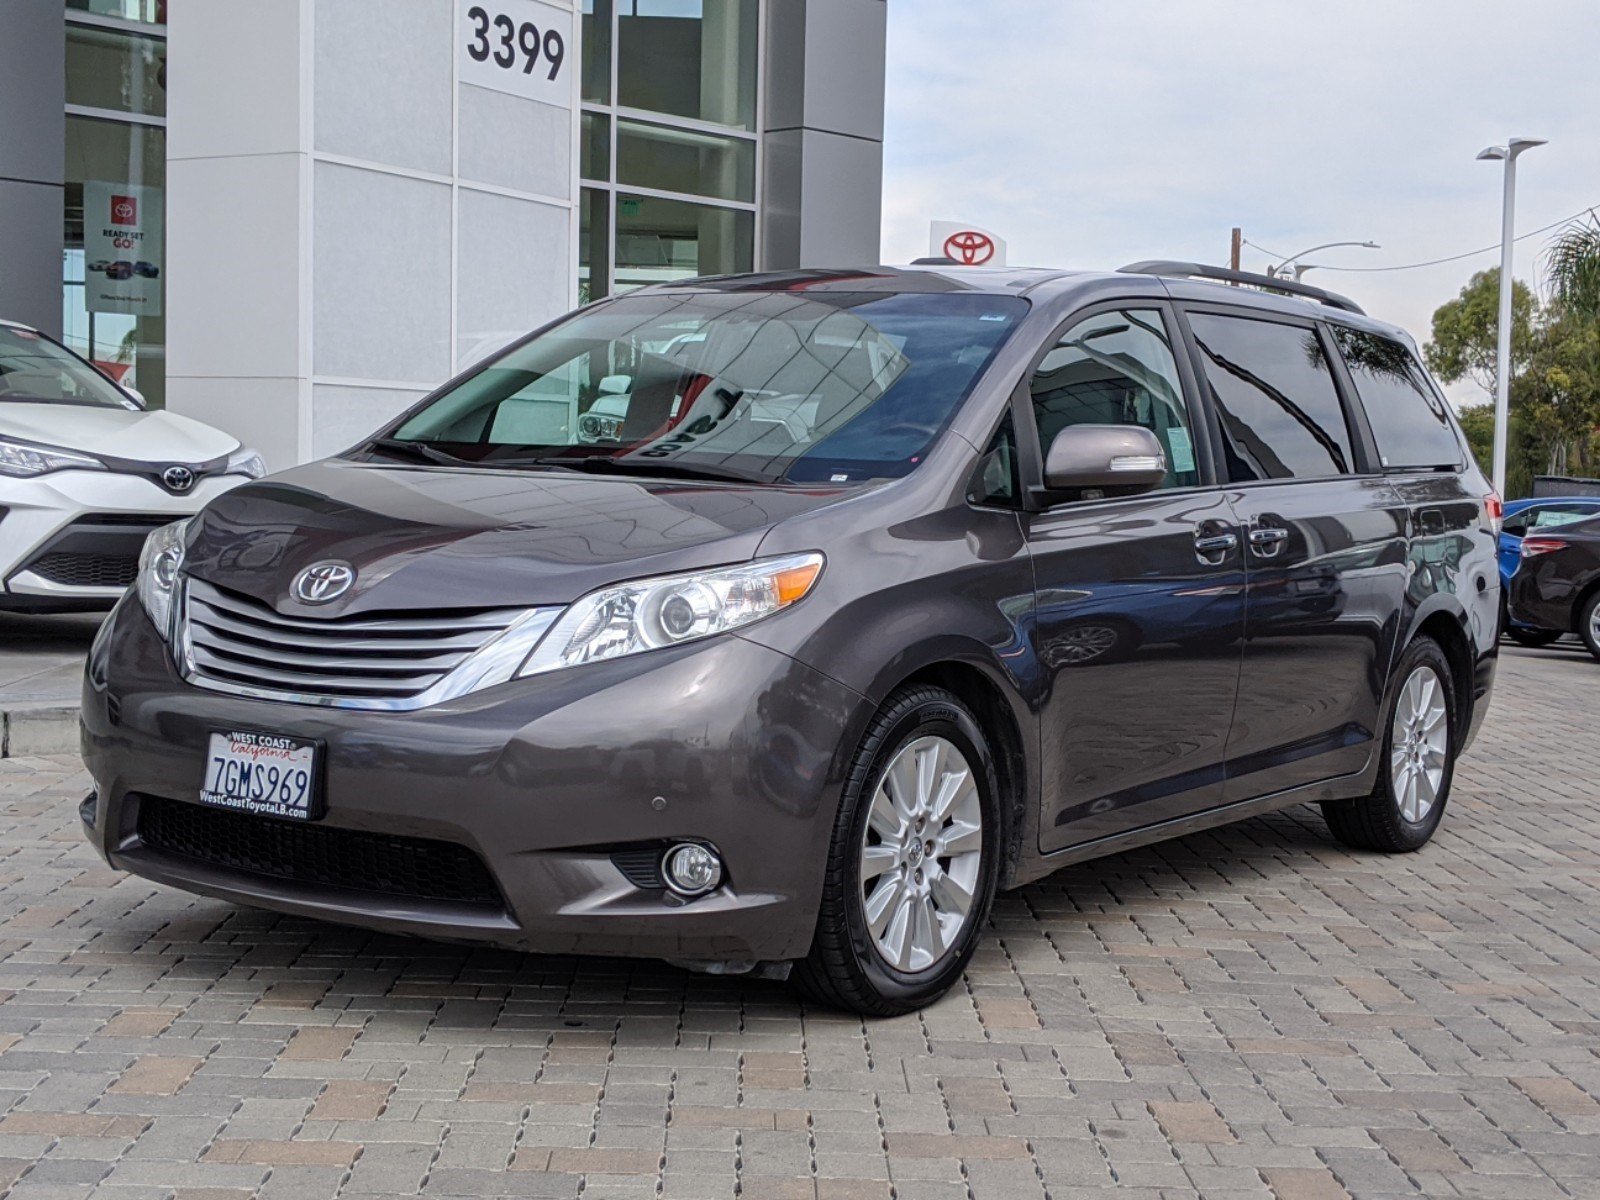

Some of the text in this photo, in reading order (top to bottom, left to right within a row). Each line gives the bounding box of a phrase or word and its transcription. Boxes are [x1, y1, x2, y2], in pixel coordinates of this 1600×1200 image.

[467, 6, 564, 81] 3399
[102, 229, 144, 240] READY SET
[113, 238, 134, 249] GO!
[231, 731, 291, 749] WEST COAST
[231, 740, 297, 762] California
[213, 756, 308, 806] 7GMS969
[199, 789, 307, 819] WestCoastToyotaLB.com
